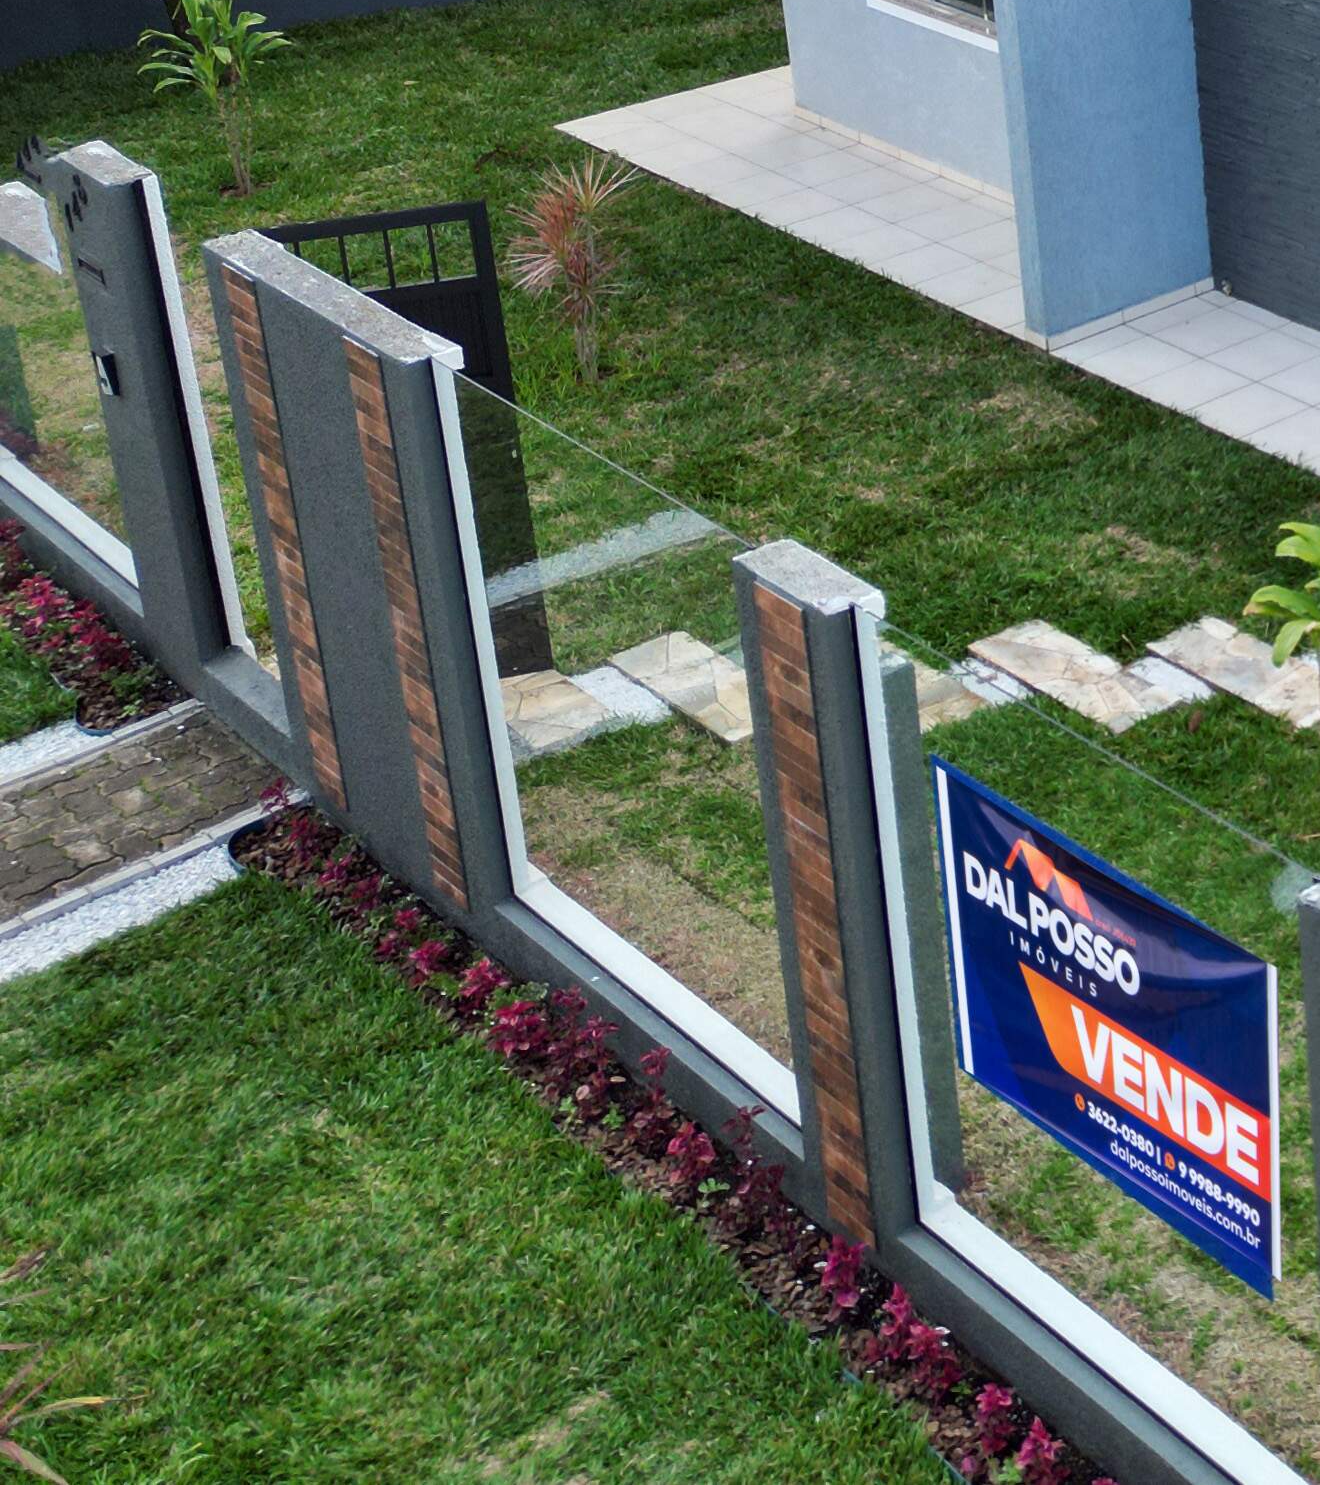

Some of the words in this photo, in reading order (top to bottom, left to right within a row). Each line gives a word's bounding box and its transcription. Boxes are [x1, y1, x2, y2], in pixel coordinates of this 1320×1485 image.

[963, 850, 1028, 930] DAL
[1028, 891, 1141, 996] POSSO
[1009, 930, 1098, 998] IMÓVEIS
[1070, 1003, 1260, 1187] VENDE
[1087, 1101, 1154, 1158] 3622-0380
[1110, 1140, 1261, 1250] dalpossoimoveis.com.br
